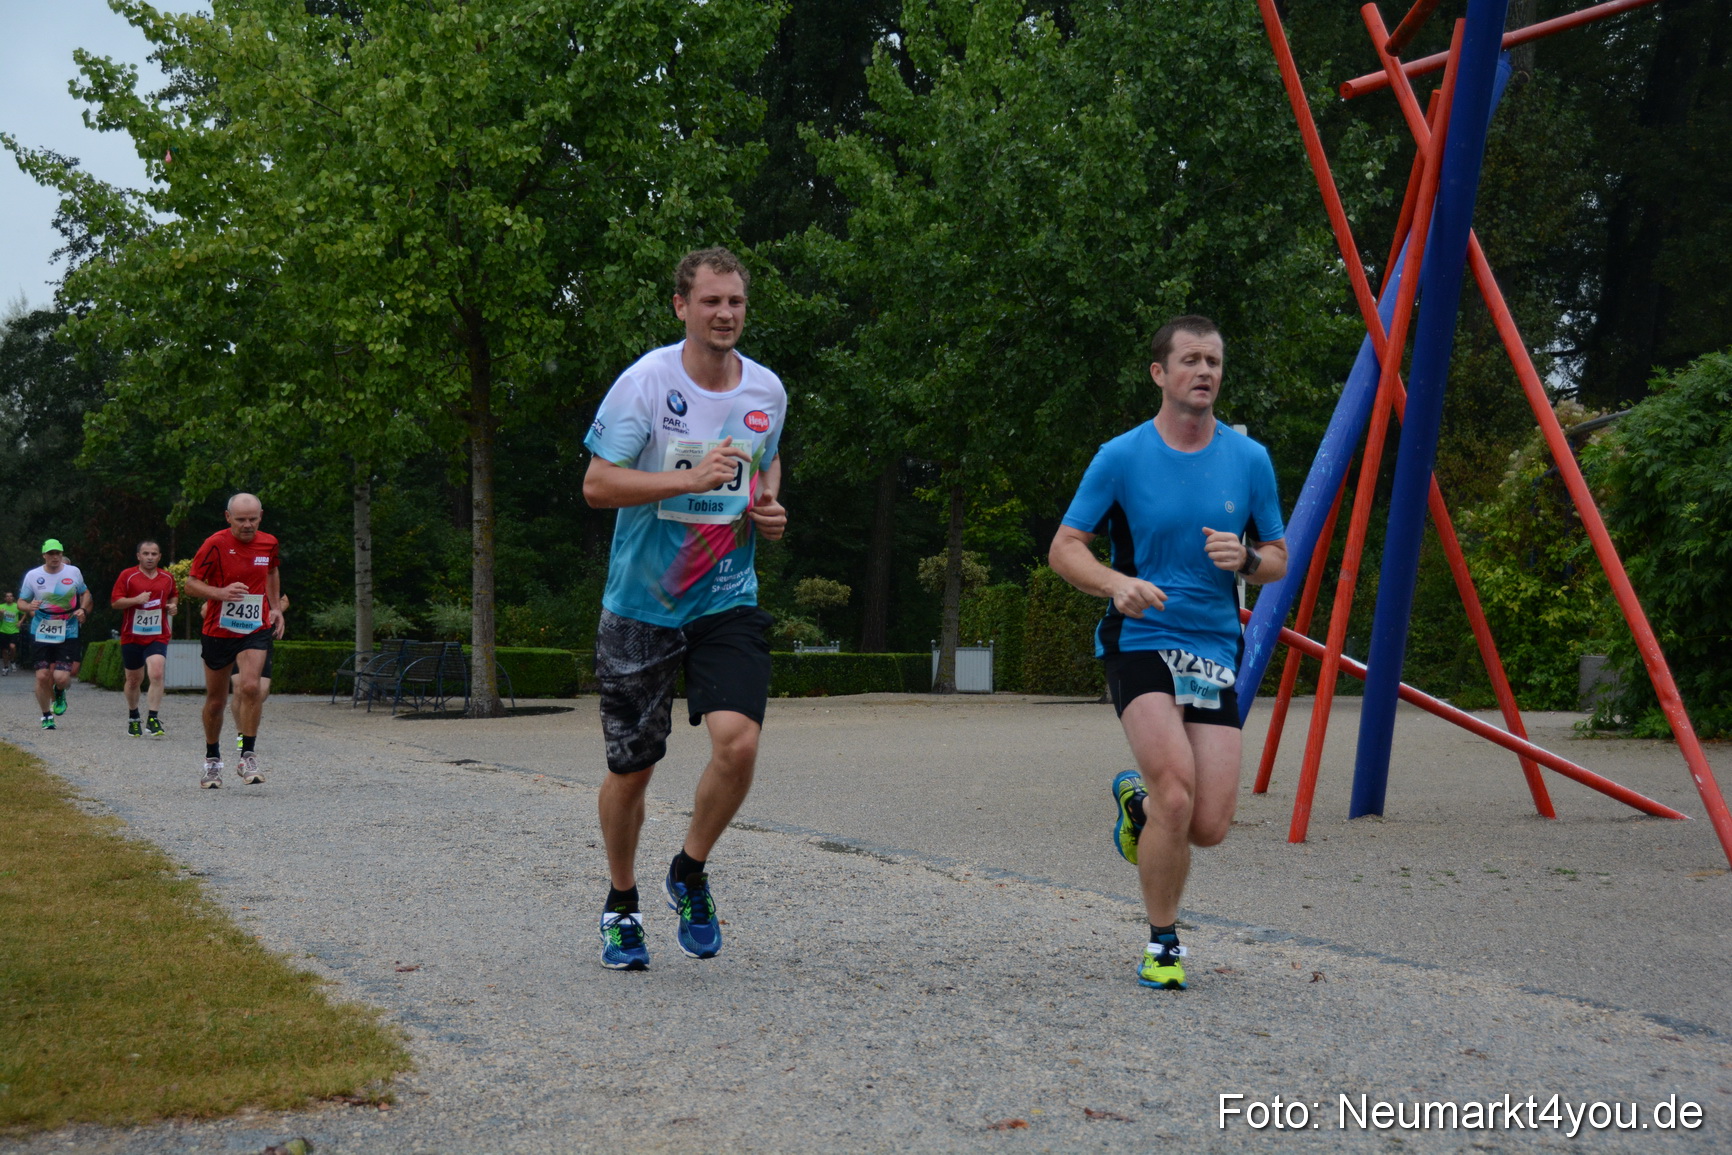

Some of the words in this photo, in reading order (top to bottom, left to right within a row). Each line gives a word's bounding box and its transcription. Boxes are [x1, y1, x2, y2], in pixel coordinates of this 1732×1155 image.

[687, 498, 724, 512] Tobias
[226, 602, 260, 619] 2438
[136, 615, 159, 626] 2417
[231, 620, 254, 629] Herbert
[39, 623, 63, 634] 2451
